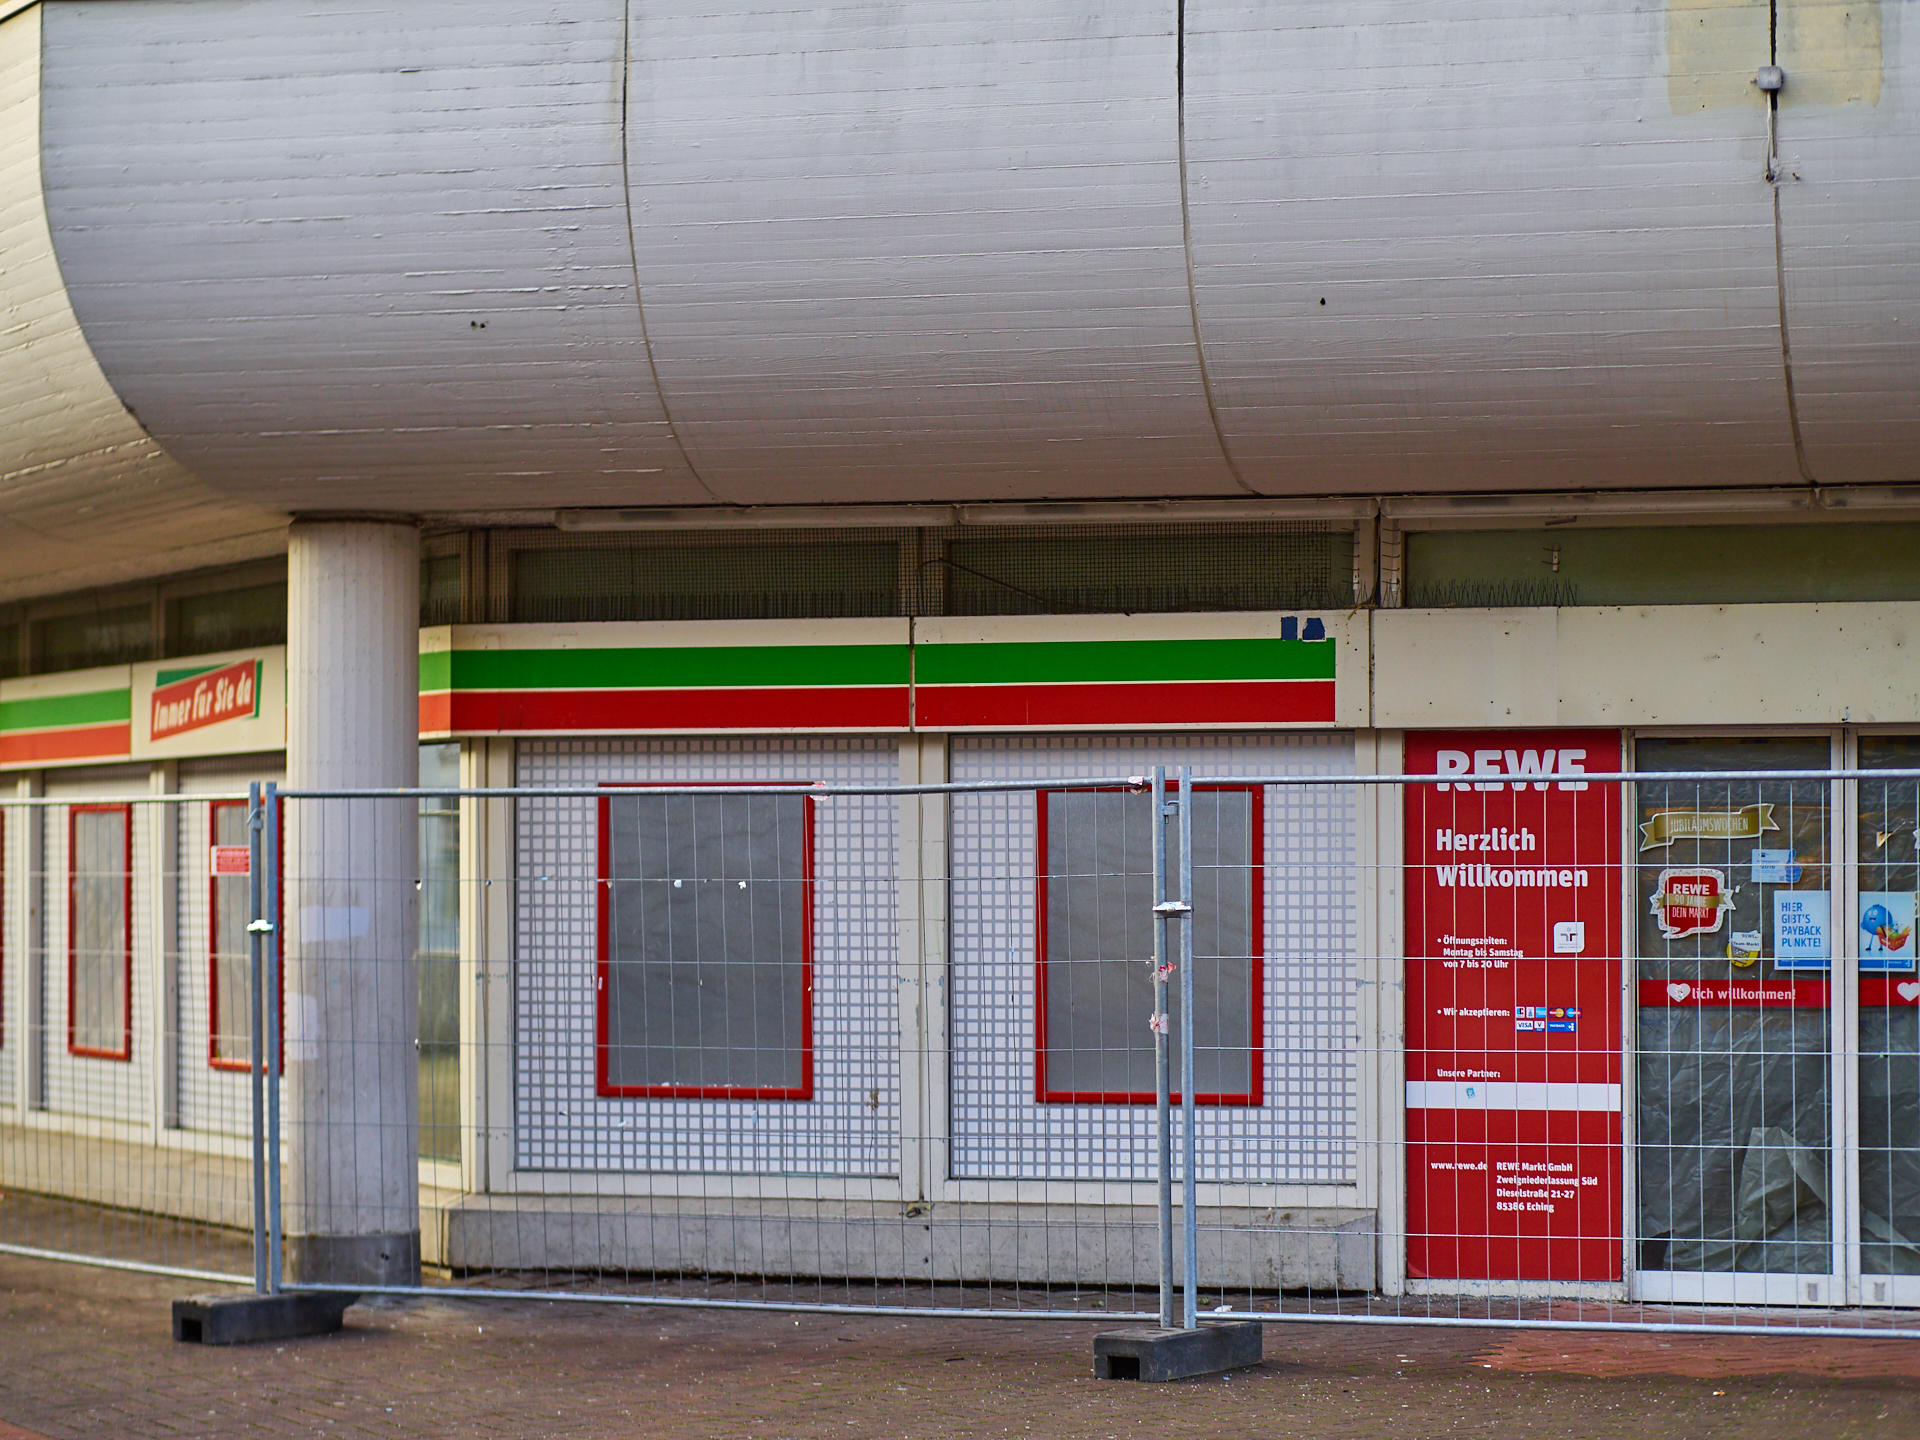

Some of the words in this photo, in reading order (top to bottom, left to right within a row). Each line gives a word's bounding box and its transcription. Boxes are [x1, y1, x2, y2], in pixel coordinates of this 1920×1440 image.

[153, 697, 191, 733] Immer
[192, 680, 213, 720] für
[214, 677, 234, 715] Sie
[236, 671, 252, 706] da
[1436, 749, 1589, 792] REWE
[1670, 815, 1749, 833] JUBILÄUMSWOCHEN
[1436, 827, 1536, 851] Herzlich
[1436, 864, 1589, 888] Willkommen
[1672, 883, 1710, 895] REWE
[1674, 895, 1684, 904] 90
[1686, 896, 1707, 907] JAHRE
[1781, 902, 1803, 912] HIER
[1672, 907, 1687, 918] DEIN
[1688, 907, 1710, 919] MARKT
[1781, 914, 1811, 924] GIBT'S
[1781, 925, 1822, 936] PAYBACK
[1443, 935, 1508, 947] Öffnungszeiten:
[1443, 948, 1473, 958] Montag
[1475, 948, 1487, 957] bis
[1489, 948, 1524, 958] Samstag
[1460, 960, 1465, 968] 7
[1467, 960, 1479, 968] bis
[1481, 960, 1493, 968] 20
[1494, 960, 1509, 968] Uhr
[1692, 984, 1714, 1000] lich
[1718, 985, 1796, 1001] willkommen!
[1443, 1008, 1457, 1016] Wir
[1459, 1008, 1510, 1018] akzeptieren:
[1437, 1069, 1465, 1078] Unsere
[1467, 1069, 1501, 1078] Partner:
[1431, 1162, 1488, 1171] www.rewe.de
[1496, 1162, 1520, 1171] REWE
[1522, 1162, 1546, 1172] Markt
[1548, 1163, 1573, 1172] GmbH
[1496, 1175, 1580, 1187] Zweigniederlassung
[1581, 1176, 1598, 1186] Süd
[1496, 1188, 1549, 1198] Dieselstraße
[1551, 1190, 1575, 1199] 21-27
[1496, 1202, 1525, 1211] 85386
[1527, 1202, 1555, 1213] Eching
